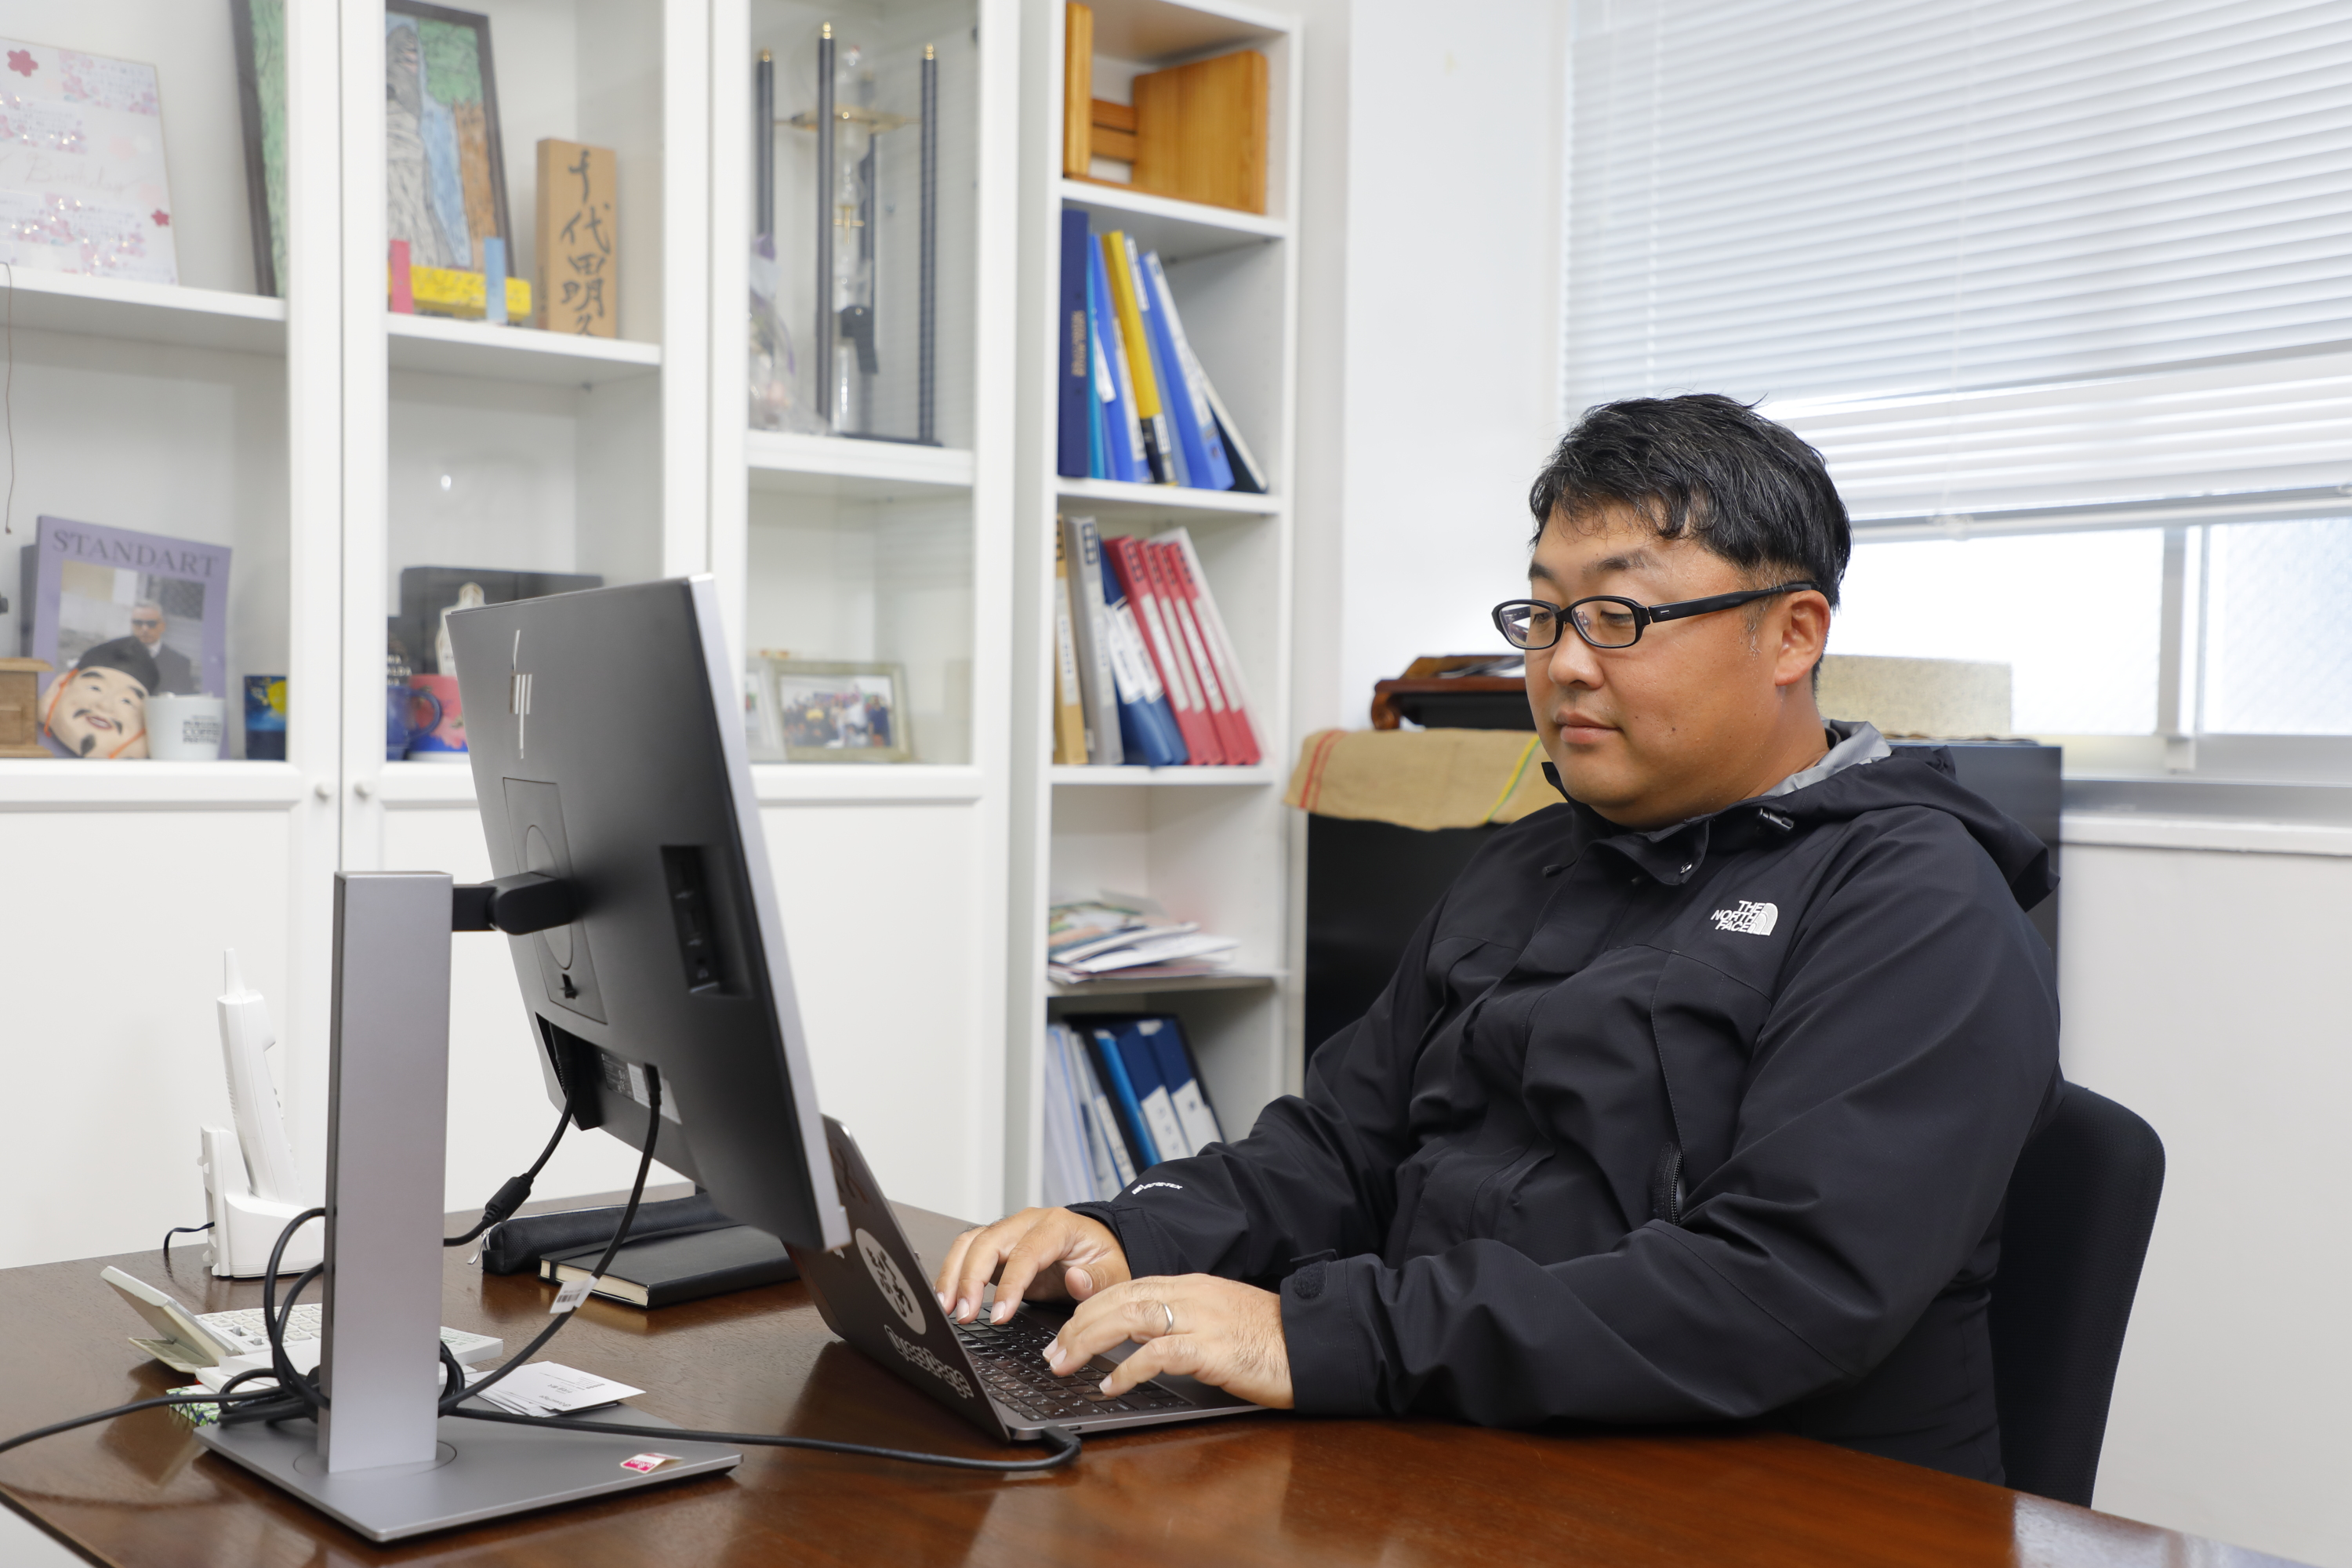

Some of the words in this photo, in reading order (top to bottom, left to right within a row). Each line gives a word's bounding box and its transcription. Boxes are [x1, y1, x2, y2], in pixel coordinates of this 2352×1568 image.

[52, 528, 219, 578] STANDART
[1738, 900, 1765, 913] THE
[1711, 909, 1757, 924] NORTH
[1715, 921, 1751, 933] FACE
